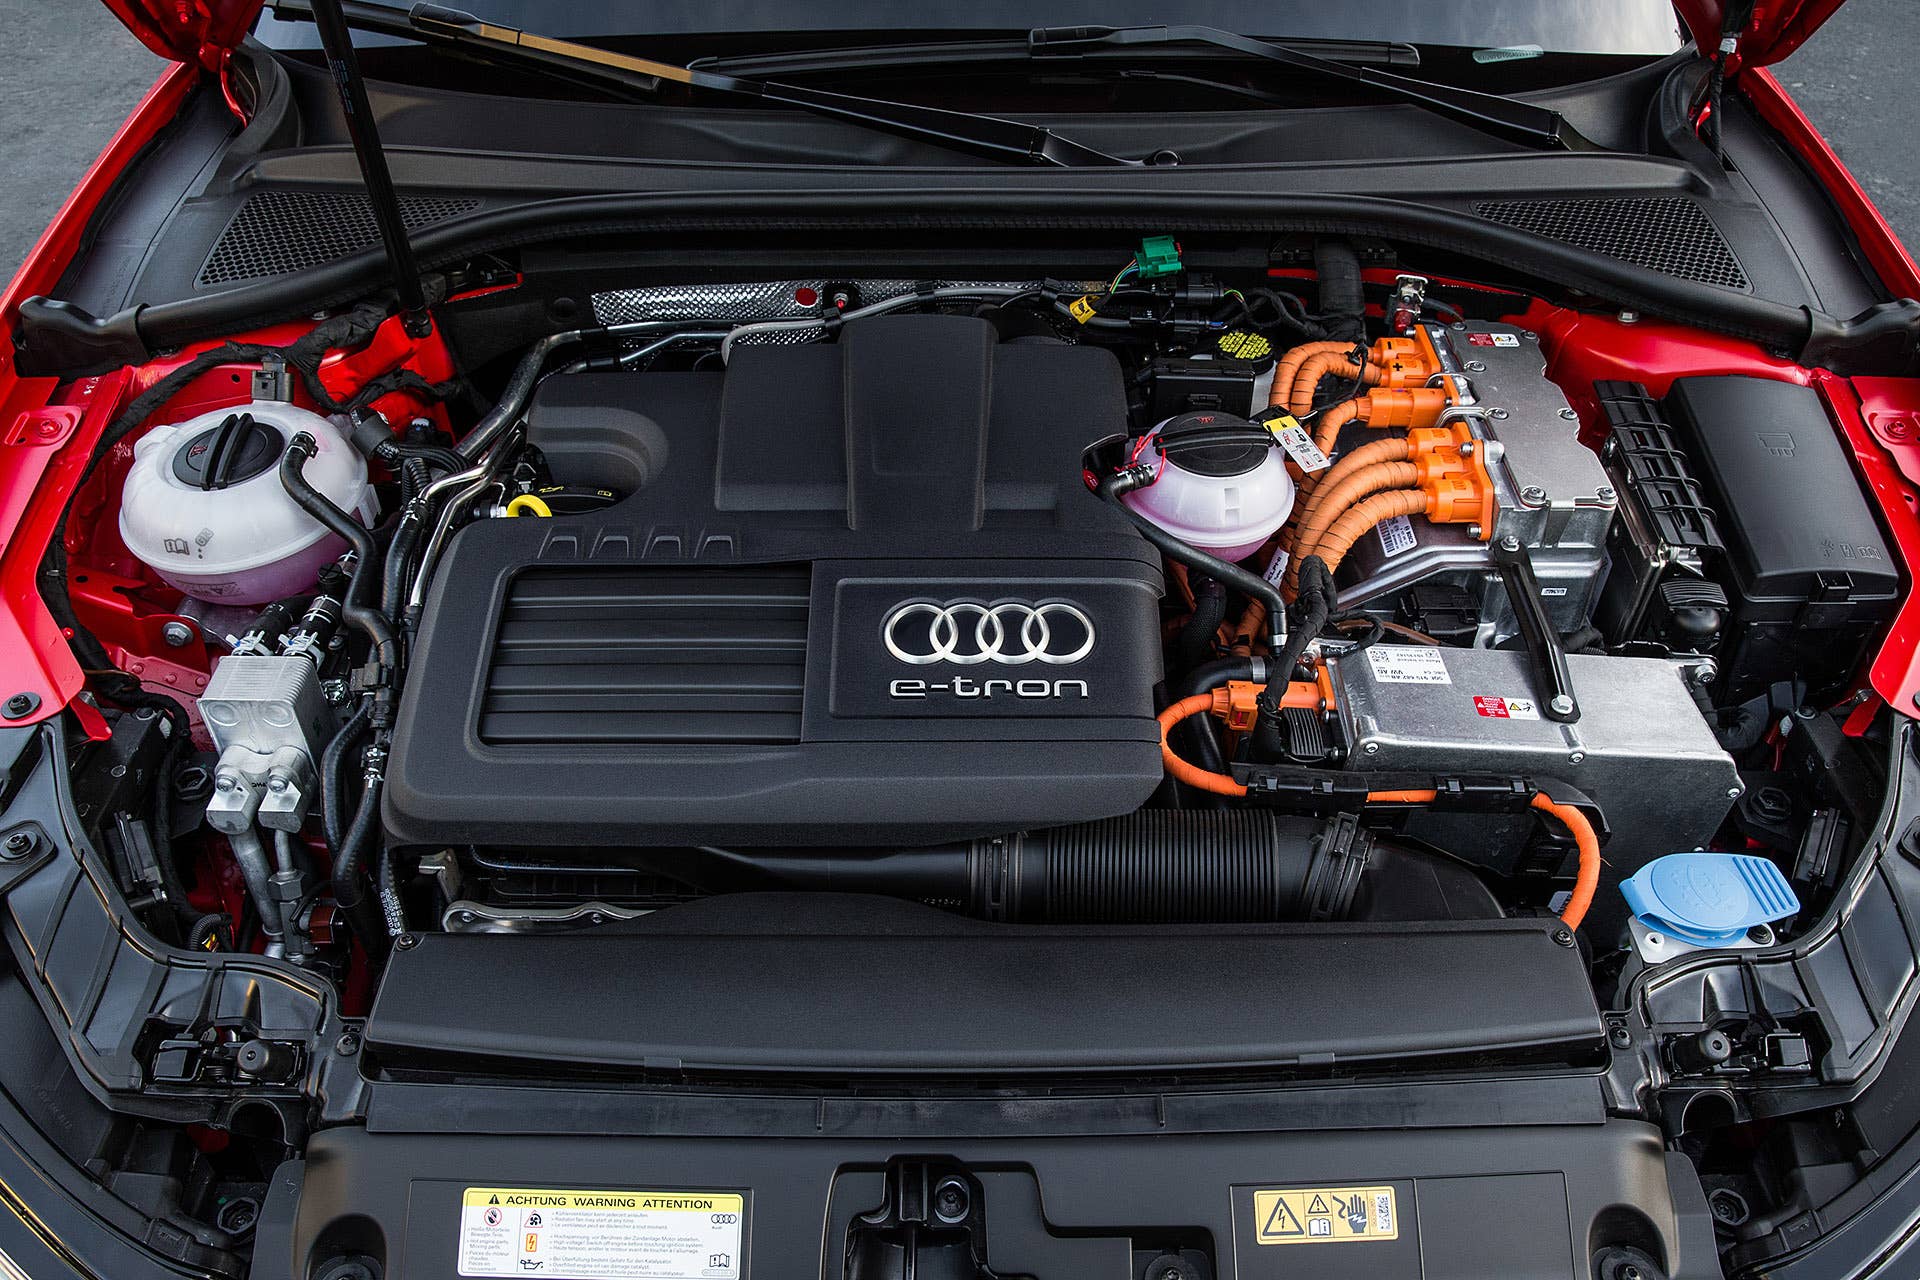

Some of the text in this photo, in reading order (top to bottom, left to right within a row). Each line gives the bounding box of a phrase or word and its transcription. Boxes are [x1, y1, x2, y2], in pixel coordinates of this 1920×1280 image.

[890, 676, 1088, 697] e-tron
[506, 1196, 712, 1209] ACHTUNG WARNING ATTENTION
